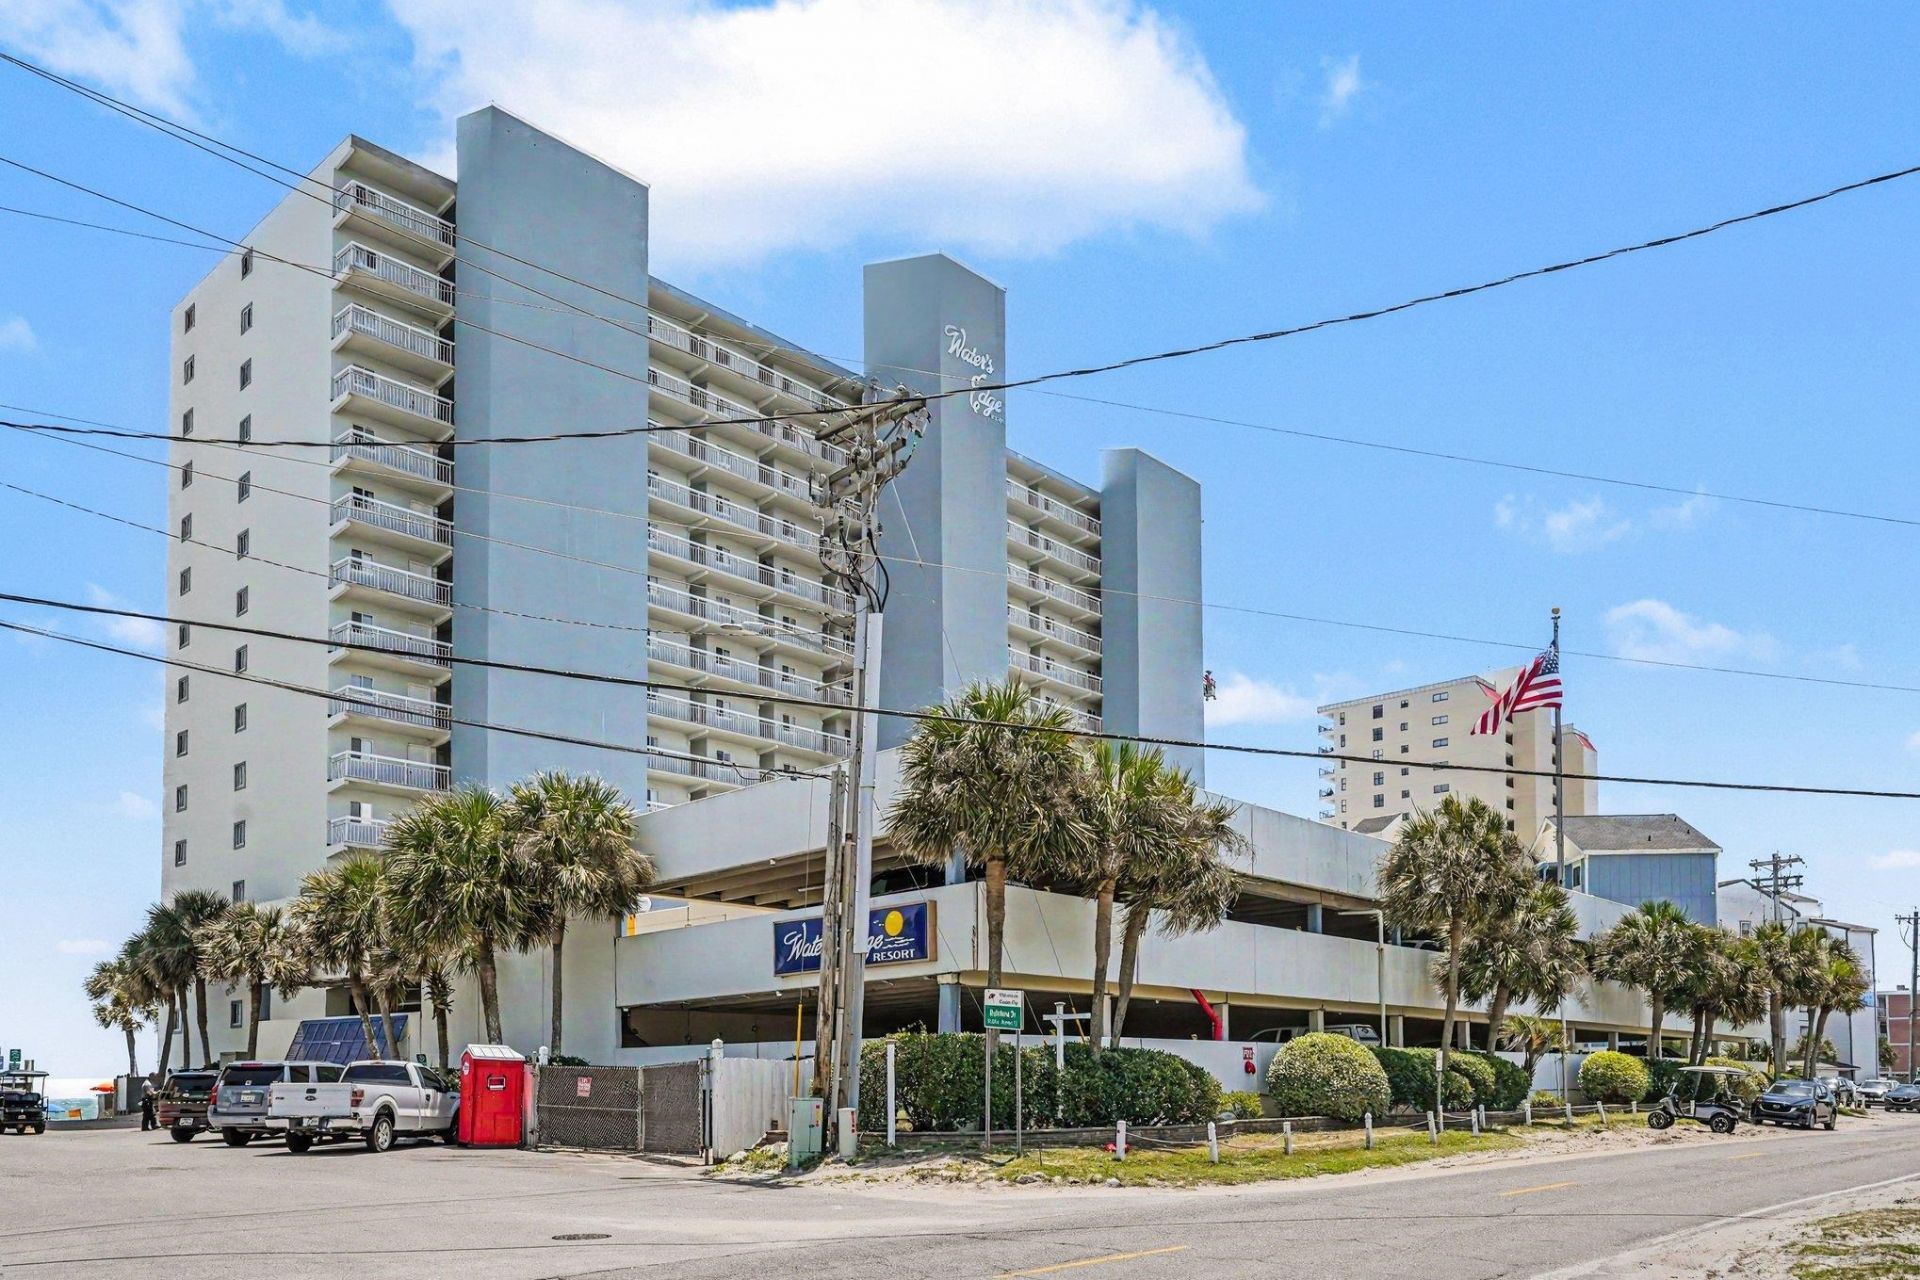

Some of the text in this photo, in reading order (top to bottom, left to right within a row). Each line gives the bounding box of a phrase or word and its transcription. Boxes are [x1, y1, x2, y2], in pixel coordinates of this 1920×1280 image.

[944, 324, 994, 373] Water's
[969, 373, 1004, 417] Edge
[872, 948, 916, 962] RESORT
